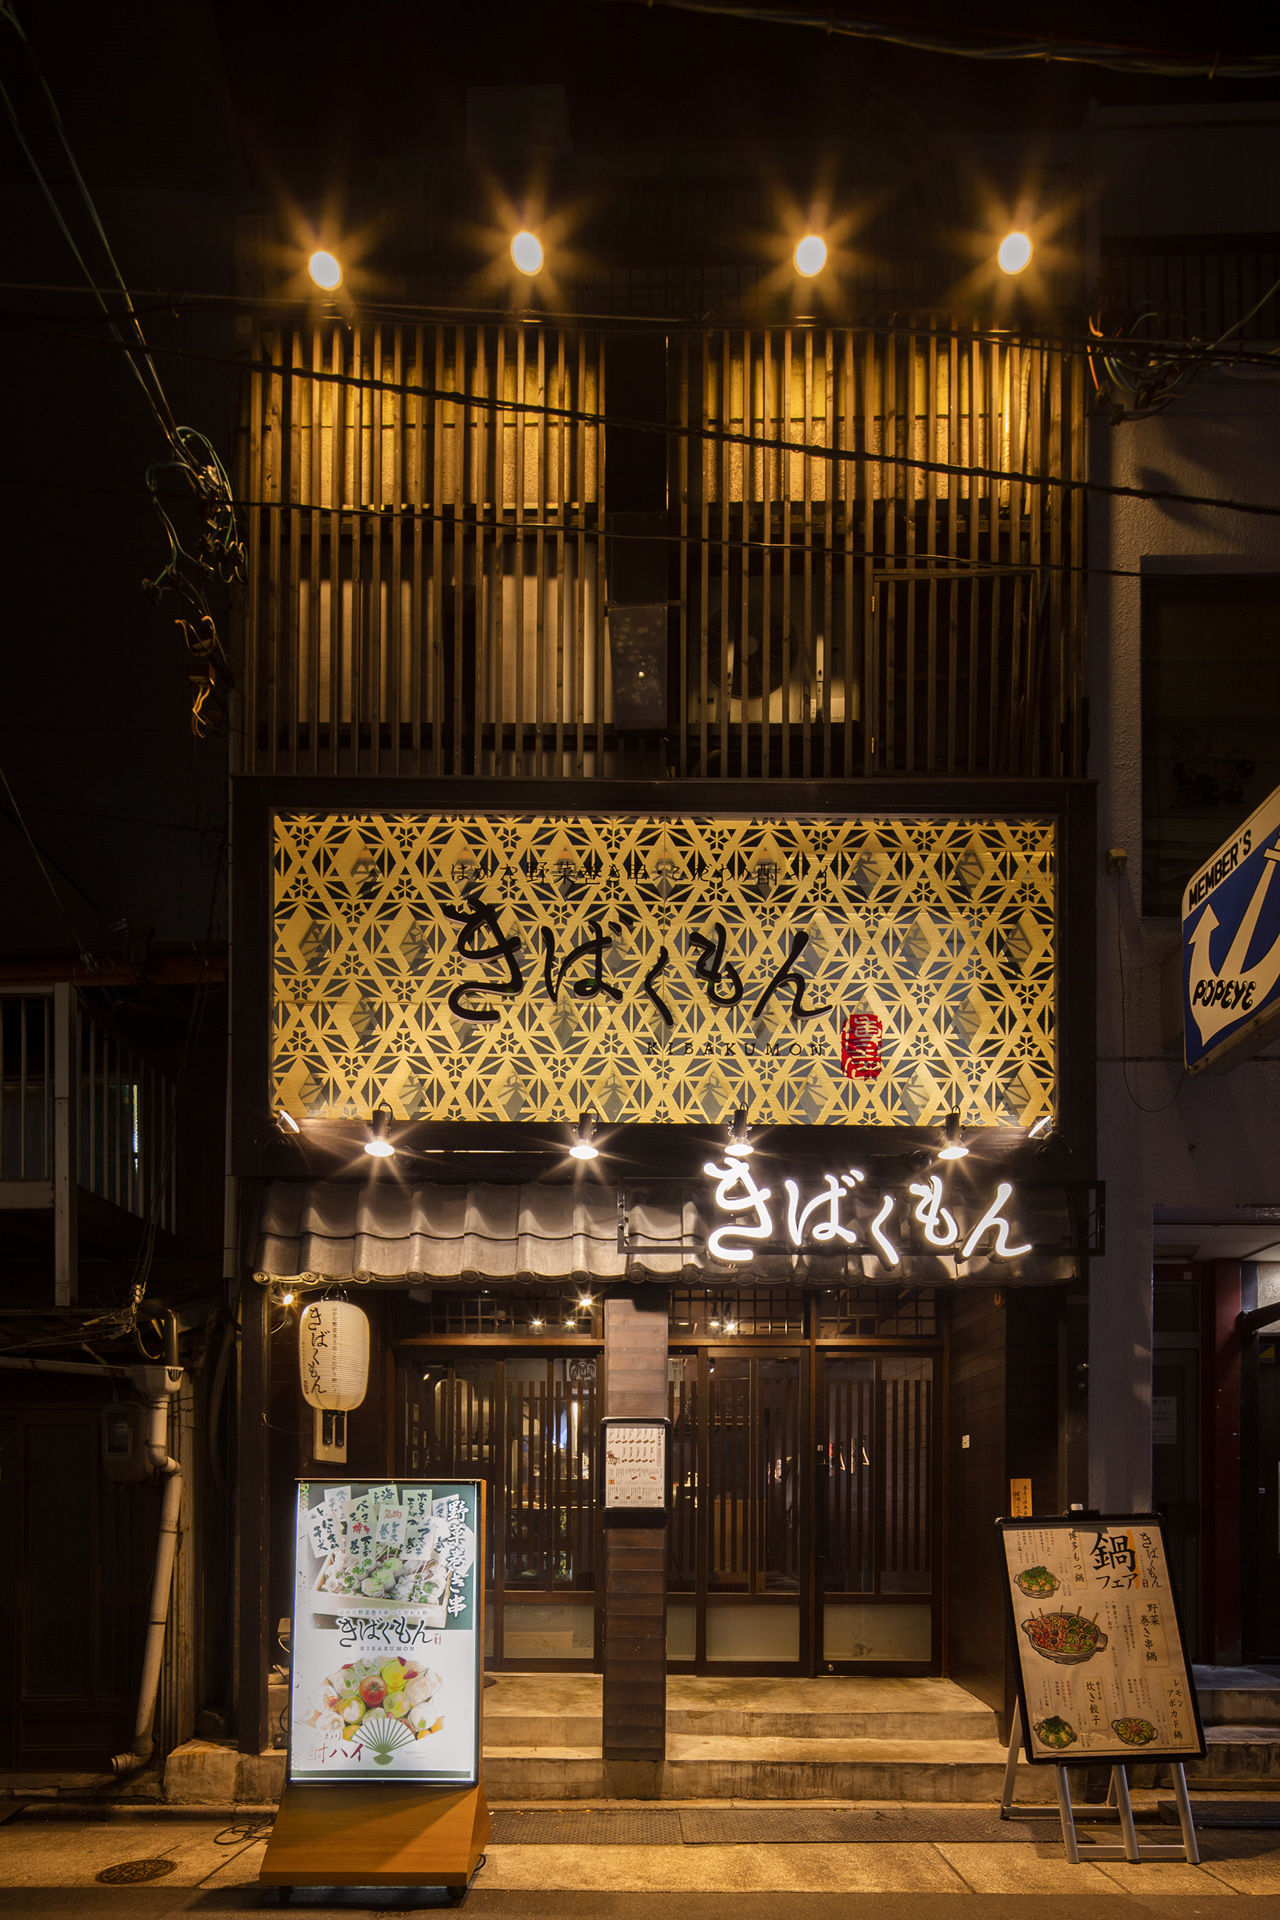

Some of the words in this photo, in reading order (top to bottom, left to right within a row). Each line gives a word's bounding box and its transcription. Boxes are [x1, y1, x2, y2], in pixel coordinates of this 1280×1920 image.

[1188, 829, 1251, 911] MEMBER'S
[443, 900, 833, 1029] きばくもん
[1192, 979, 1256, 1011] POPEYE
[646, 1041, 823, 1056] KIBAKUMON
[703, 1157, 1033, 1265] きばくもん
[308, 1307, 330, 1394] きばくもん
[1068, 1531, 1085, 1582] 博多もつ鍋
[1089, 1532, 1136, 1573] 鍋
[1140, 1532, 1162, 1588] きばくもん
[1096, 1573, 1138, 1590] フェア
[338, 1616, 433, 1648] きばくもん
[1140, 1614, 1158, 1662] 巻き串鍋
[1086, 1681, 1101, 1725] 炊き餃子
[1173, 1679, 1184, 1708] レモン
